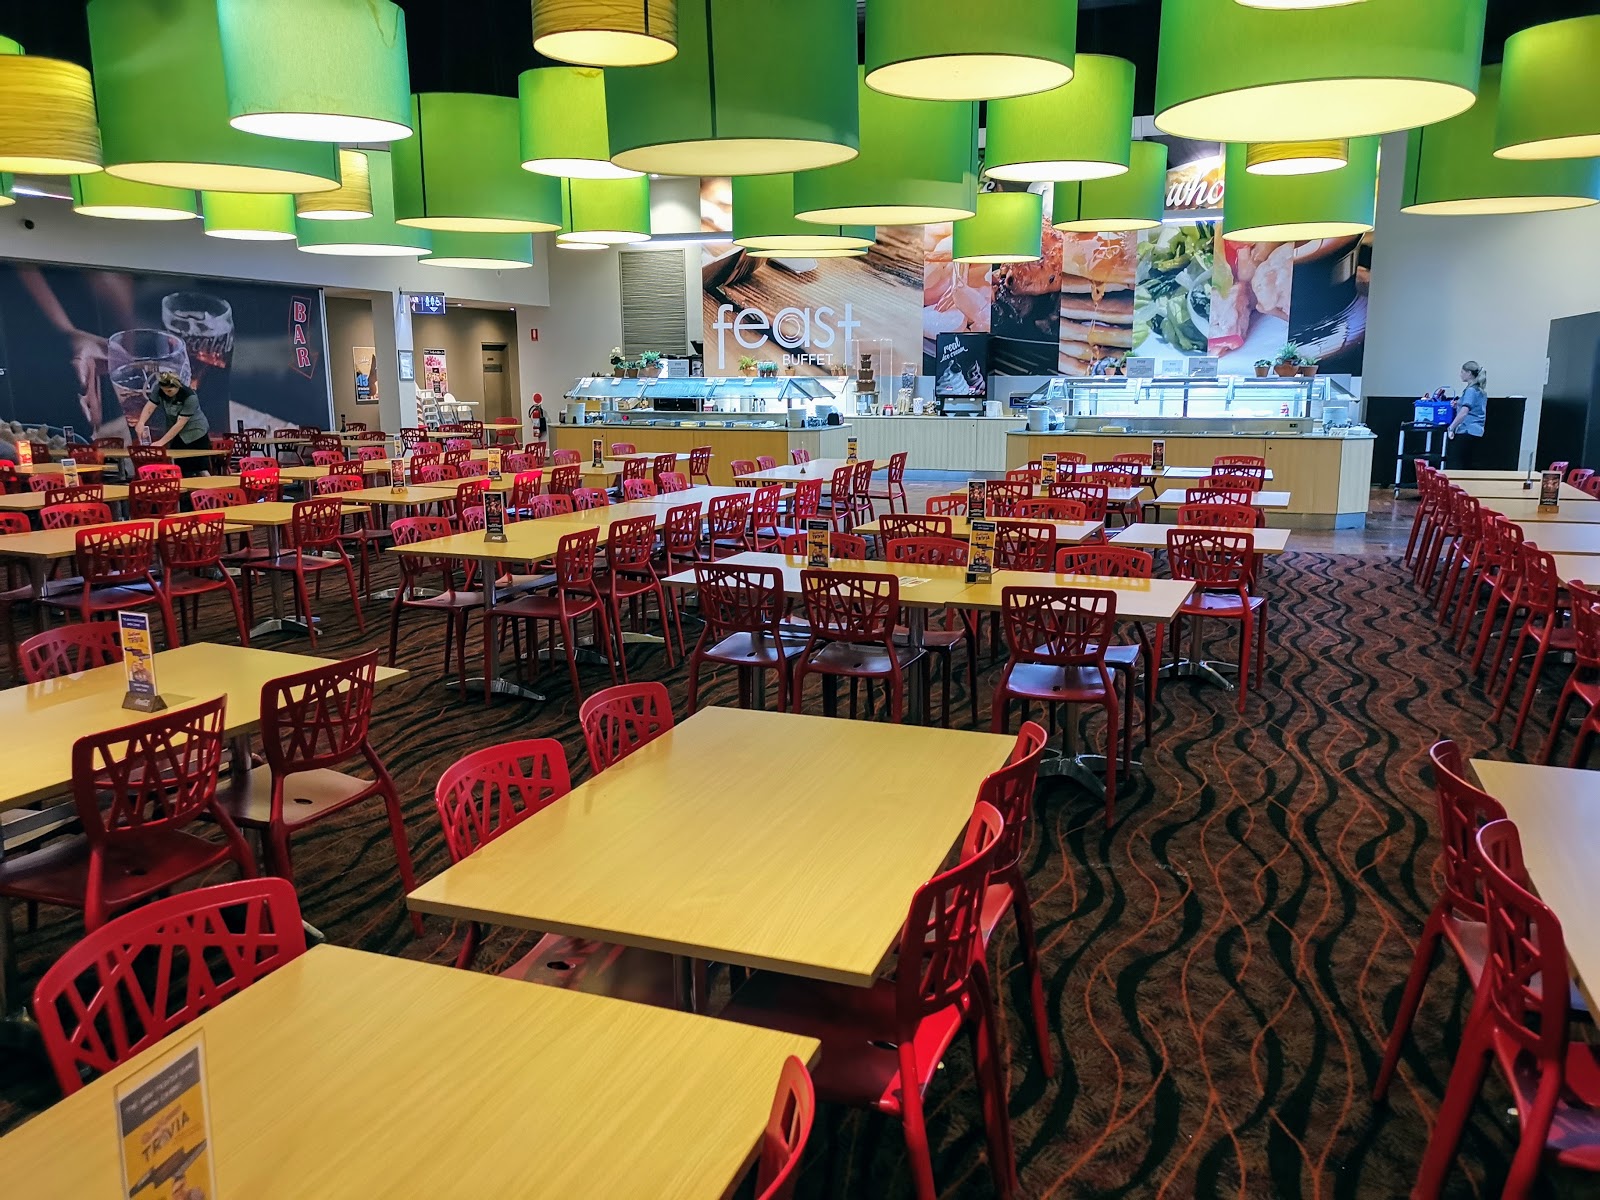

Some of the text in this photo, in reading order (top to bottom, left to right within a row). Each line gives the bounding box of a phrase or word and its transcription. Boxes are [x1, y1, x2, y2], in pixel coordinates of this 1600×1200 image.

[293, 301, 311, 368] BAR
[712, 303, 861, 370] feast
[782, 353, 834, 366] BUFFET
